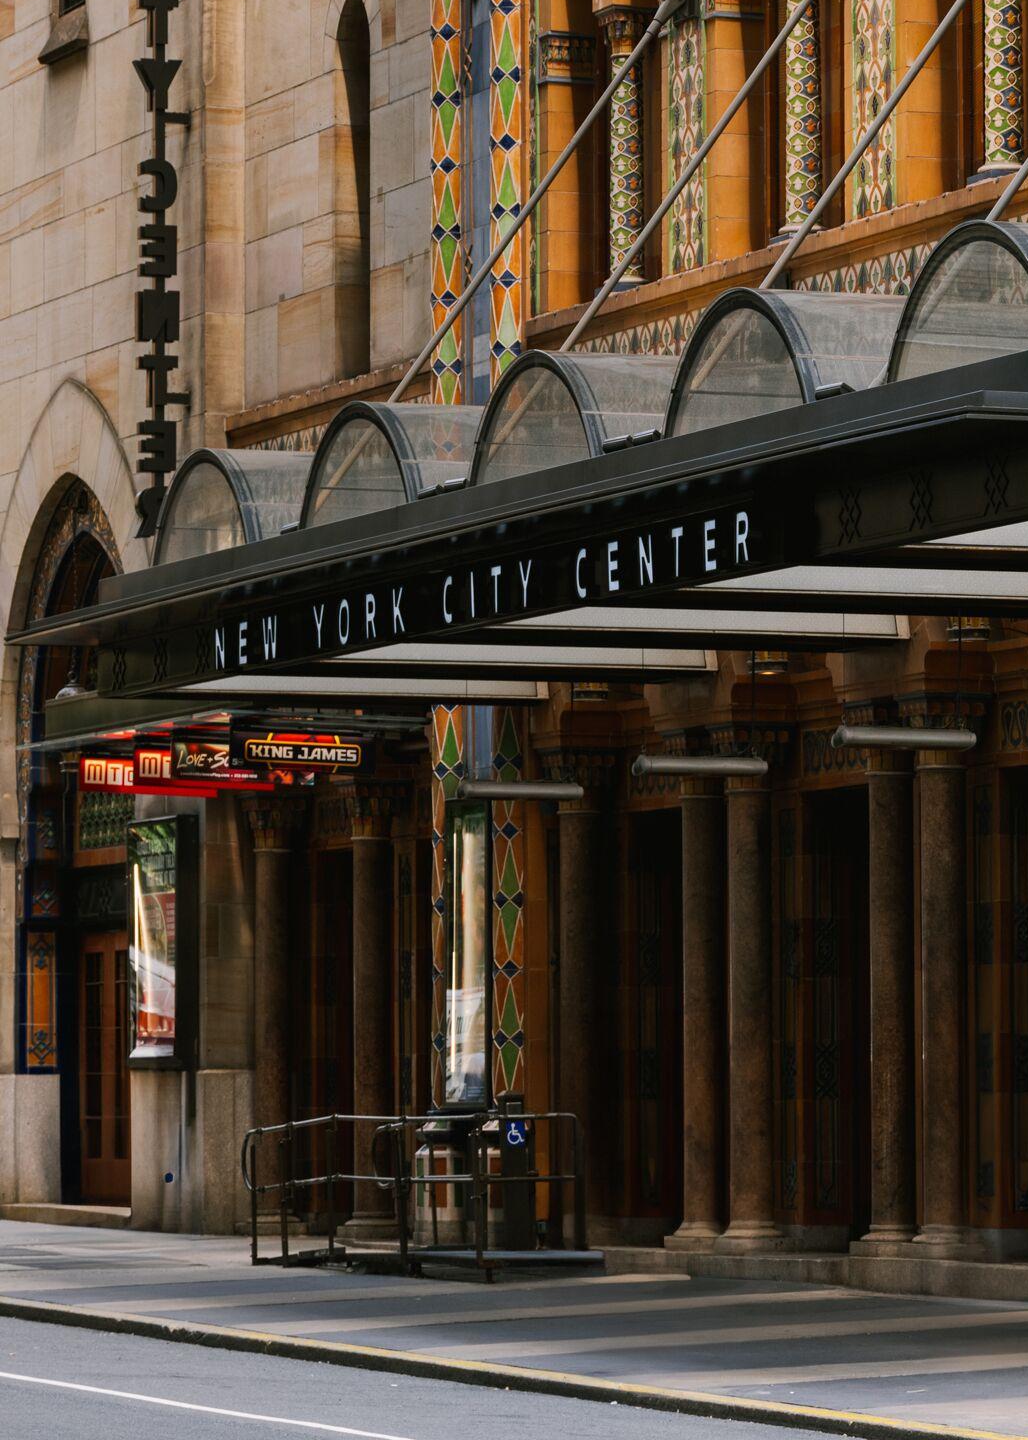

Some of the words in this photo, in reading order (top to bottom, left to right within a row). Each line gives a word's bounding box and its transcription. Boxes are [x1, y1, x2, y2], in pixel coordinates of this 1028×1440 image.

[215, 615, 278, 670] NEW
[312, 587, 406, 647] YORK
[442, 559, 533, 623] CITY
[576, 511, 750, 597] CENTER
[249, 744, 294, 759] KING
[297, 747, 357, 762] JAMES
